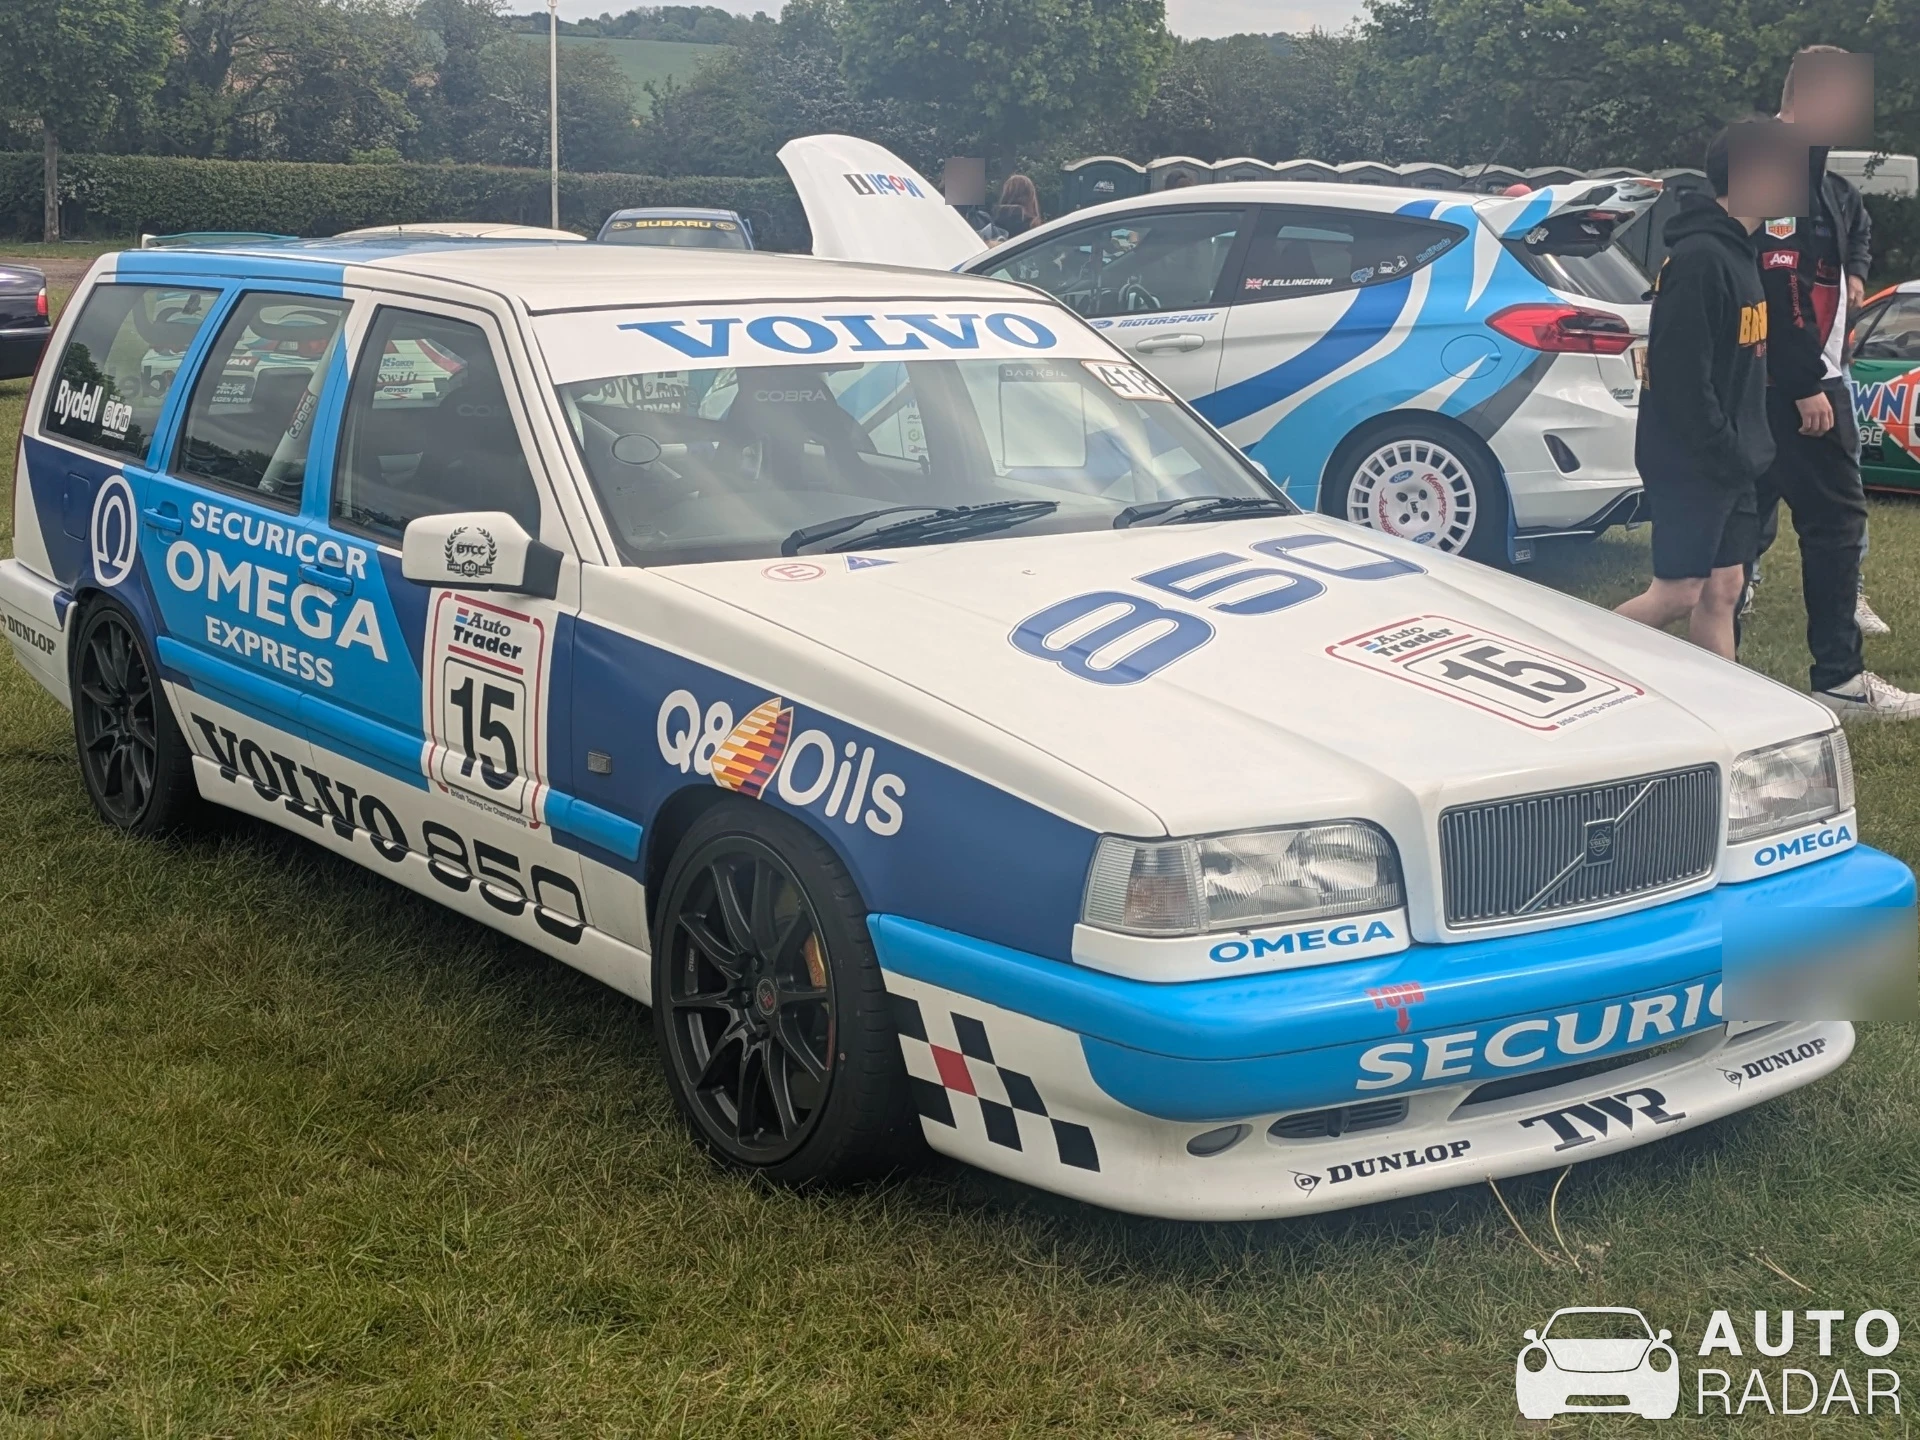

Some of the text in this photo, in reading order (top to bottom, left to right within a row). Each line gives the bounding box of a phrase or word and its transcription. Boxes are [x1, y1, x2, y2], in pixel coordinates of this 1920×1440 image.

[864, 173, 926, 199] Mobil
[635, 220, 711, 228] SUBARU
[617, 312, 1058, 359] VOLVO
[1118, 312, 1219, 328] MOTORSPORT
[54, 379, 103, 425] Rydell
[754, 389, 827, 402] COBRA
[1851, 381, 1909, 424] WN
[1860, 425, 1884, 446] GE
[190, 501, 368, 580] SECURICOR
[456, 543, 487, 556] BTCC
[463, 562, 477, 572] 60
[166, 540, 389, 663] OMEGA
[467, 611, 512, 637] Auto
[1007, 534, 1428, 687] 850
[7, 613, 56, 656] DUNLOP
[205, 614, 334, 688] EXPRESS
[453, 624, 523, 660] Trader
[1372, 627, 1454, 657] Trader
[1374, 626, 1425, 646] Auto
[1439, 645, 1587, 704] 15
[451, 676, 519, 791] 15
[656, 688, 906, 837] Q8 Oils
[192, 712, 410, 863] VOLVO
[1754, 824, 1853, 869] OMEGA
[421, 820, 587, 946] 850
[1208, 919, 1396, 965] OMEGA
[1365, 981, 1425, 1010] TOW
[1355, 983, 1722, 1090] SECURI
[1742, 1037, 1828, 1079] DUNLOP
[1518, 1086, 1685, 1153] TWR
[1326, 1139, 1472, 1185] DUNLOP
